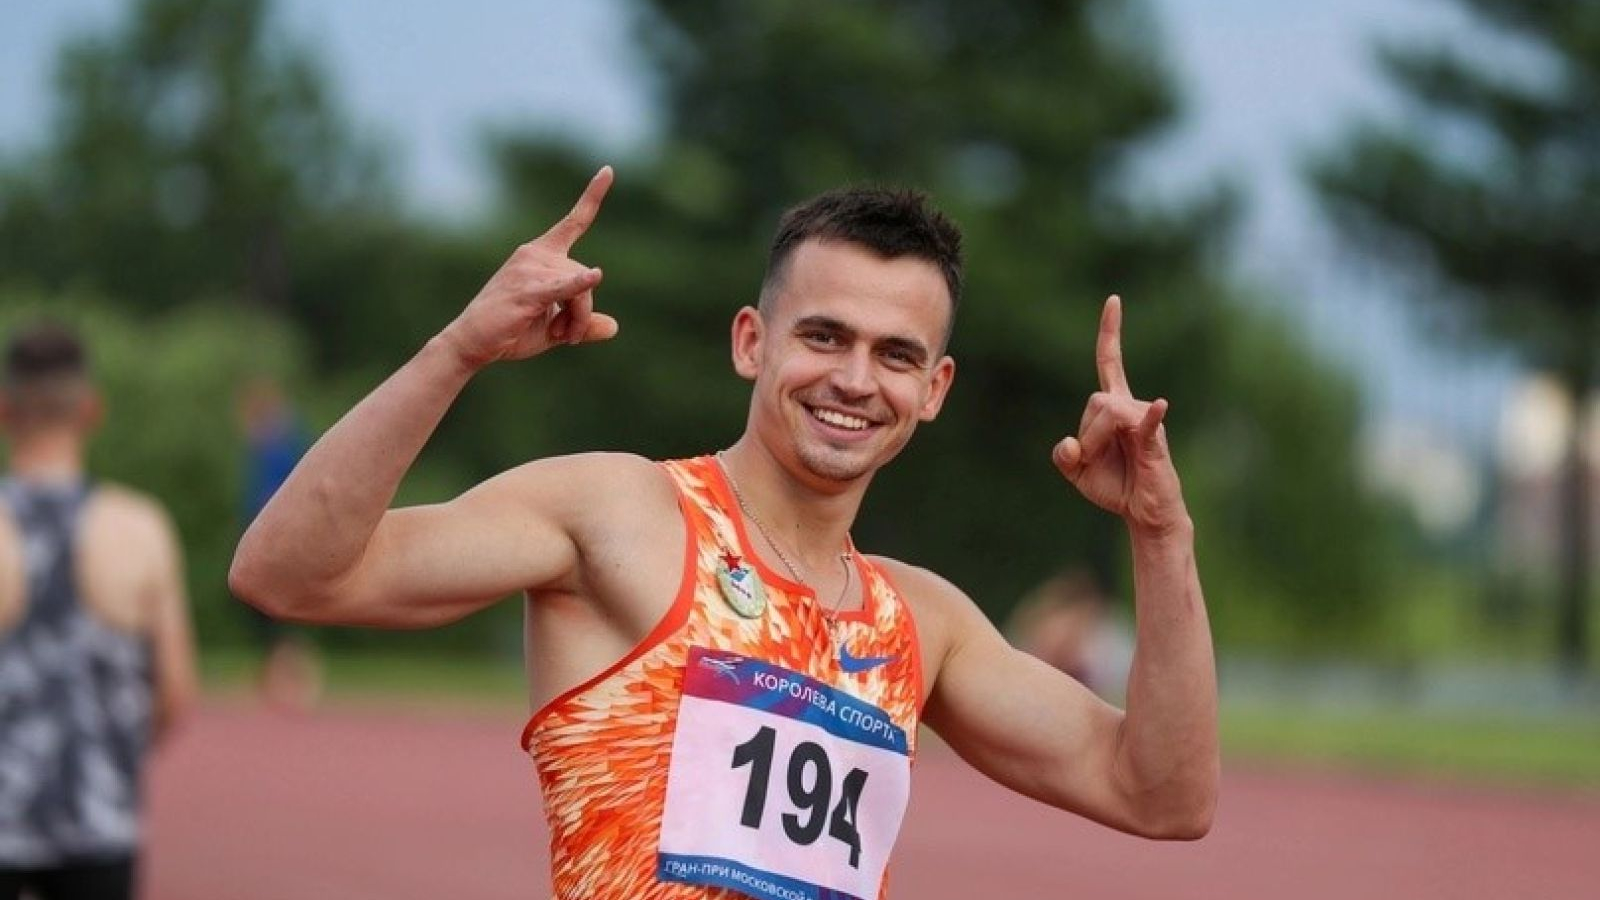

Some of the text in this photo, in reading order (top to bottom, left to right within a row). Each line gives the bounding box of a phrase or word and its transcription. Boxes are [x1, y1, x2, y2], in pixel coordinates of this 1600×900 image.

[753, 671, 896, 744] КОРОЛЕВА СПОРТА
[731, 725, 869, 869] 194
[664, 860, 729, 878] ГРАН-ПРИ
